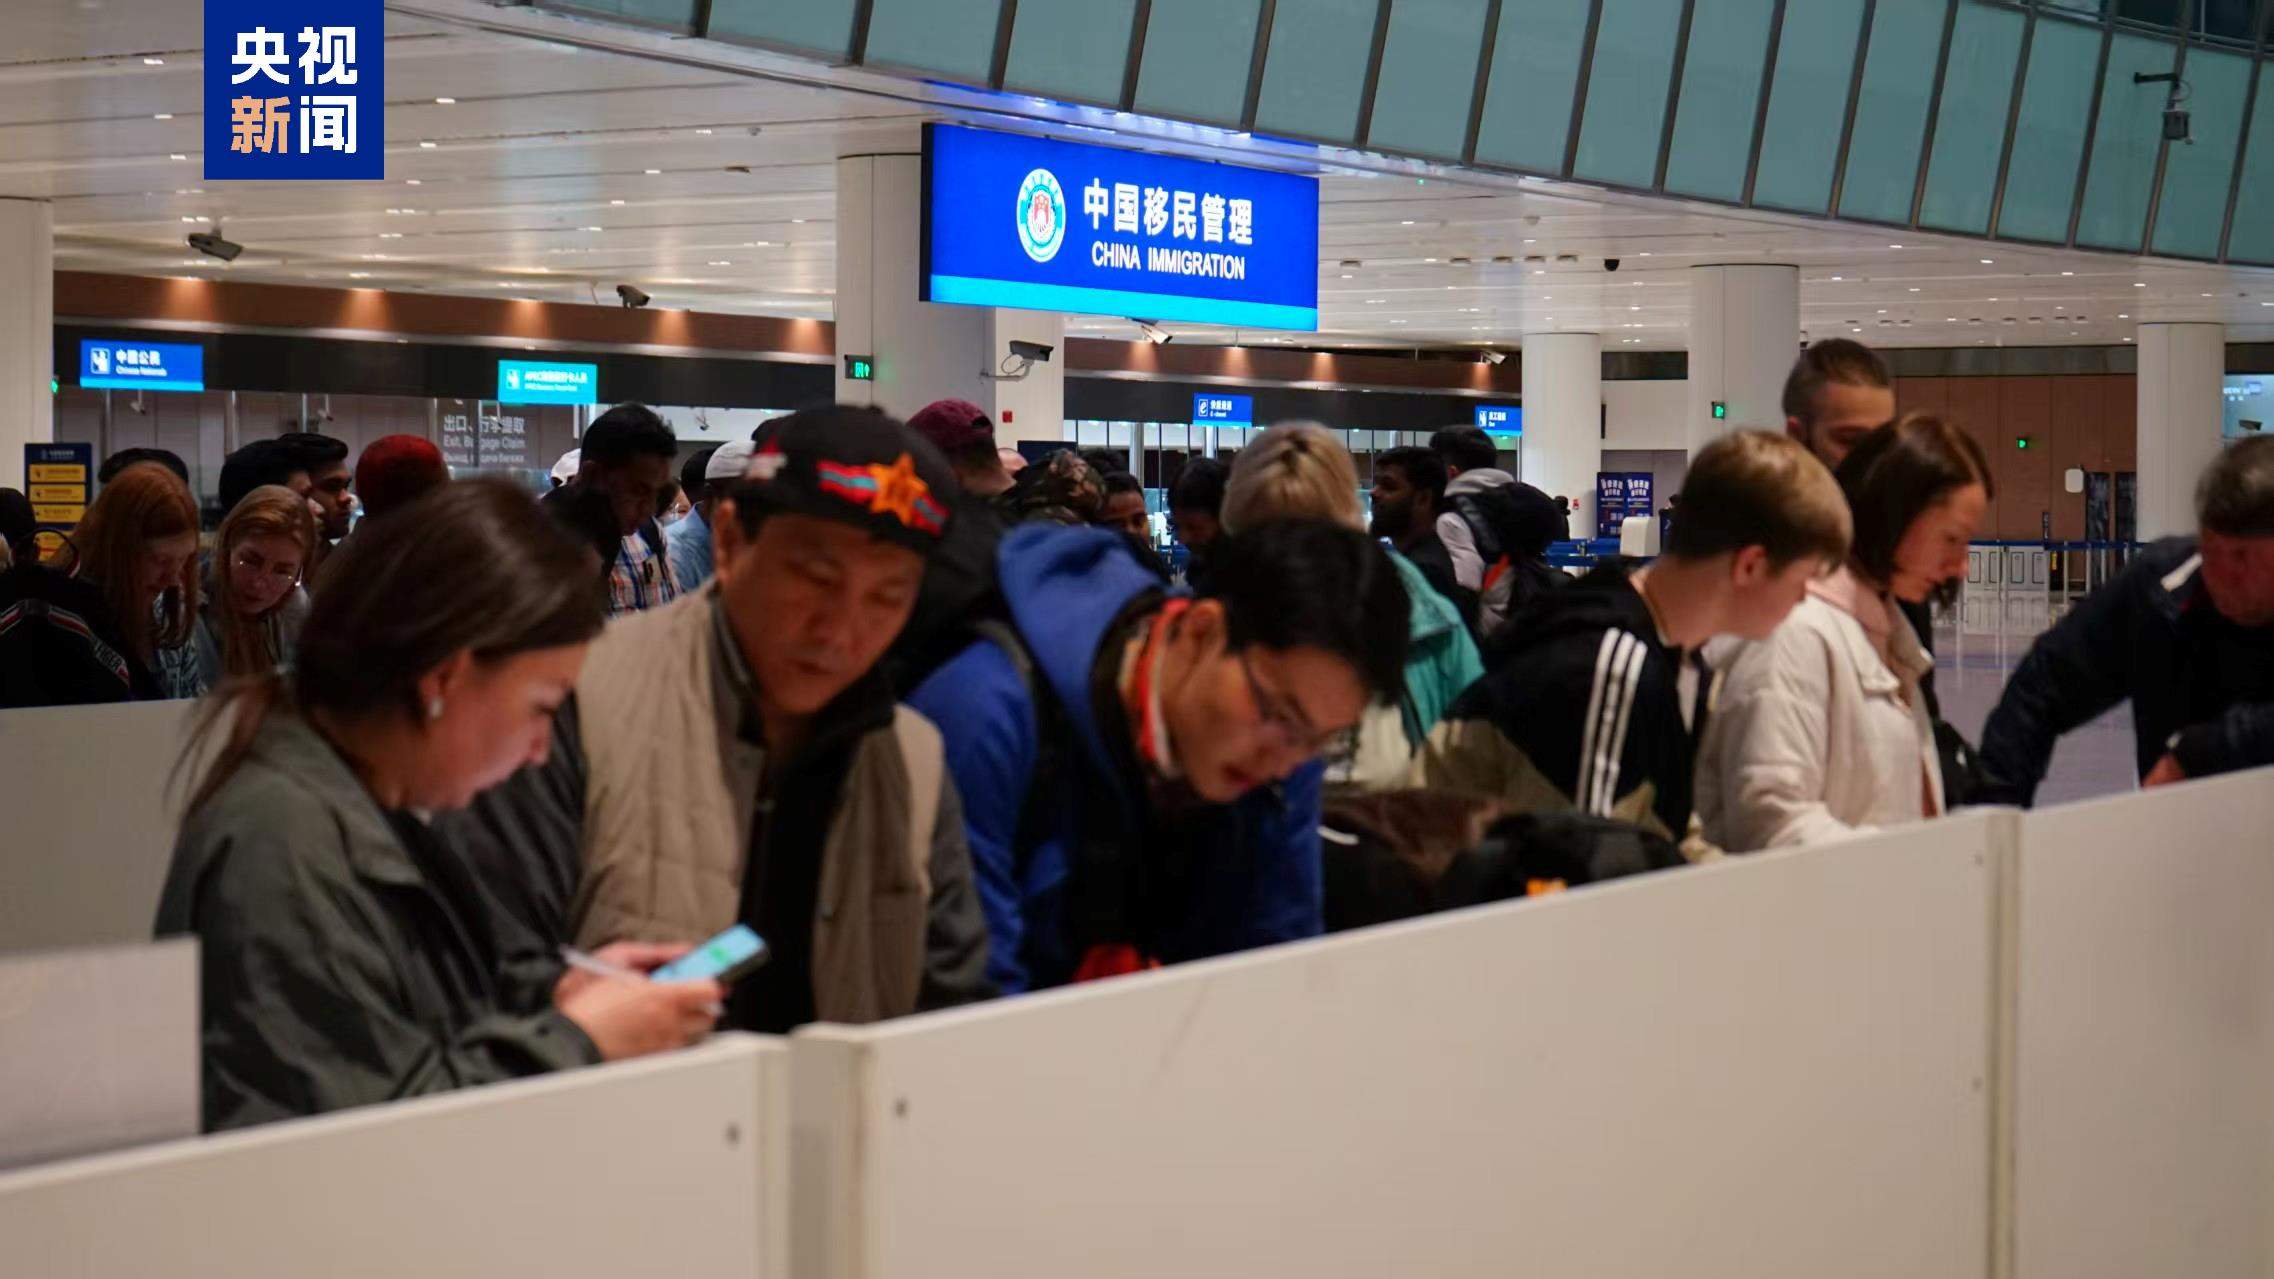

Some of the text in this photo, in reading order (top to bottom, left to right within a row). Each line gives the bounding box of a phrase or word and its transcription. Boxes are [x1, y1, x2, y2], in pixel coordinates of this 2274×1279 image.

[1084, 177, 1252, 245] 中国移民管理
[1091, 240, 1246, 280] CHINA IMMIGRATION
